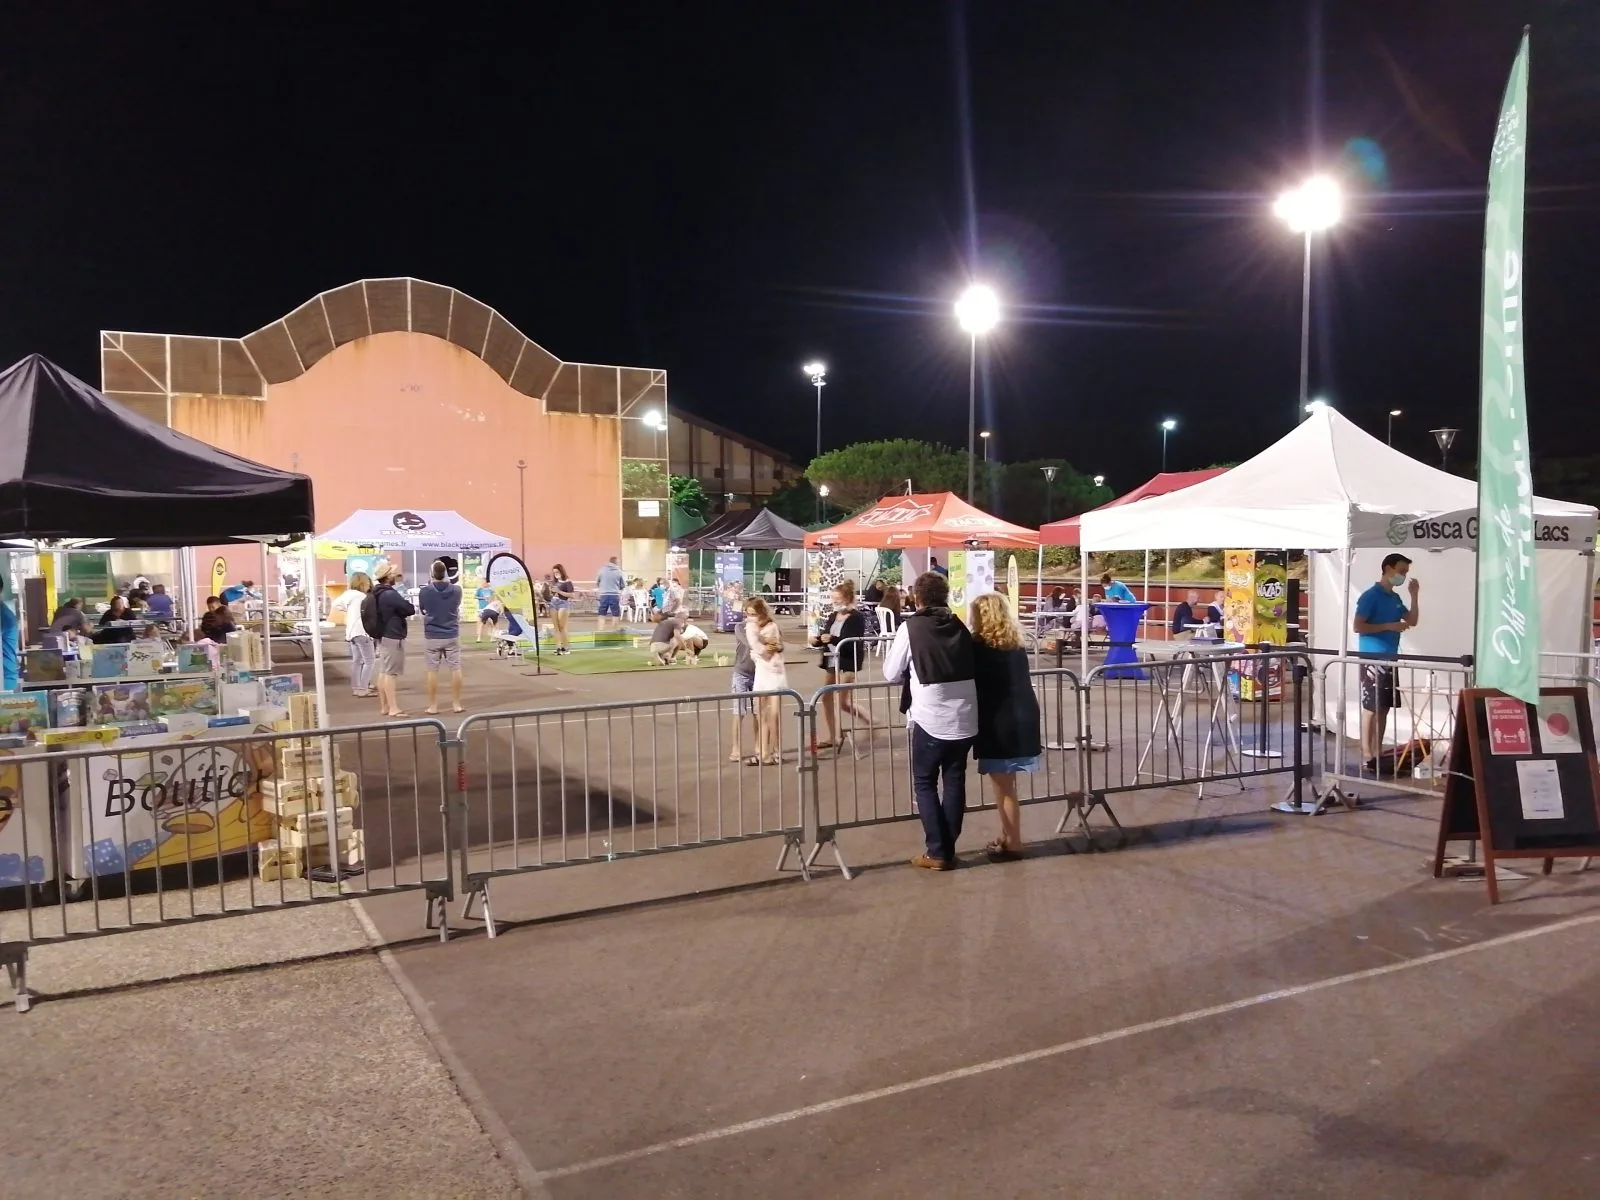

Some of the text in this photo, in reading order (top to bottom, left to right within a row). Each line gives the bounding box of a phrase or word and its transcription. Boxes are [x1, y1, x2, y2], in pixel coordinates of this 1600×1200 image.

[1413, 519, 1462, 540] Bisca
[1534, 519, 1568, 541] Lacs
[1491, 503, 1524, 665] Office de
